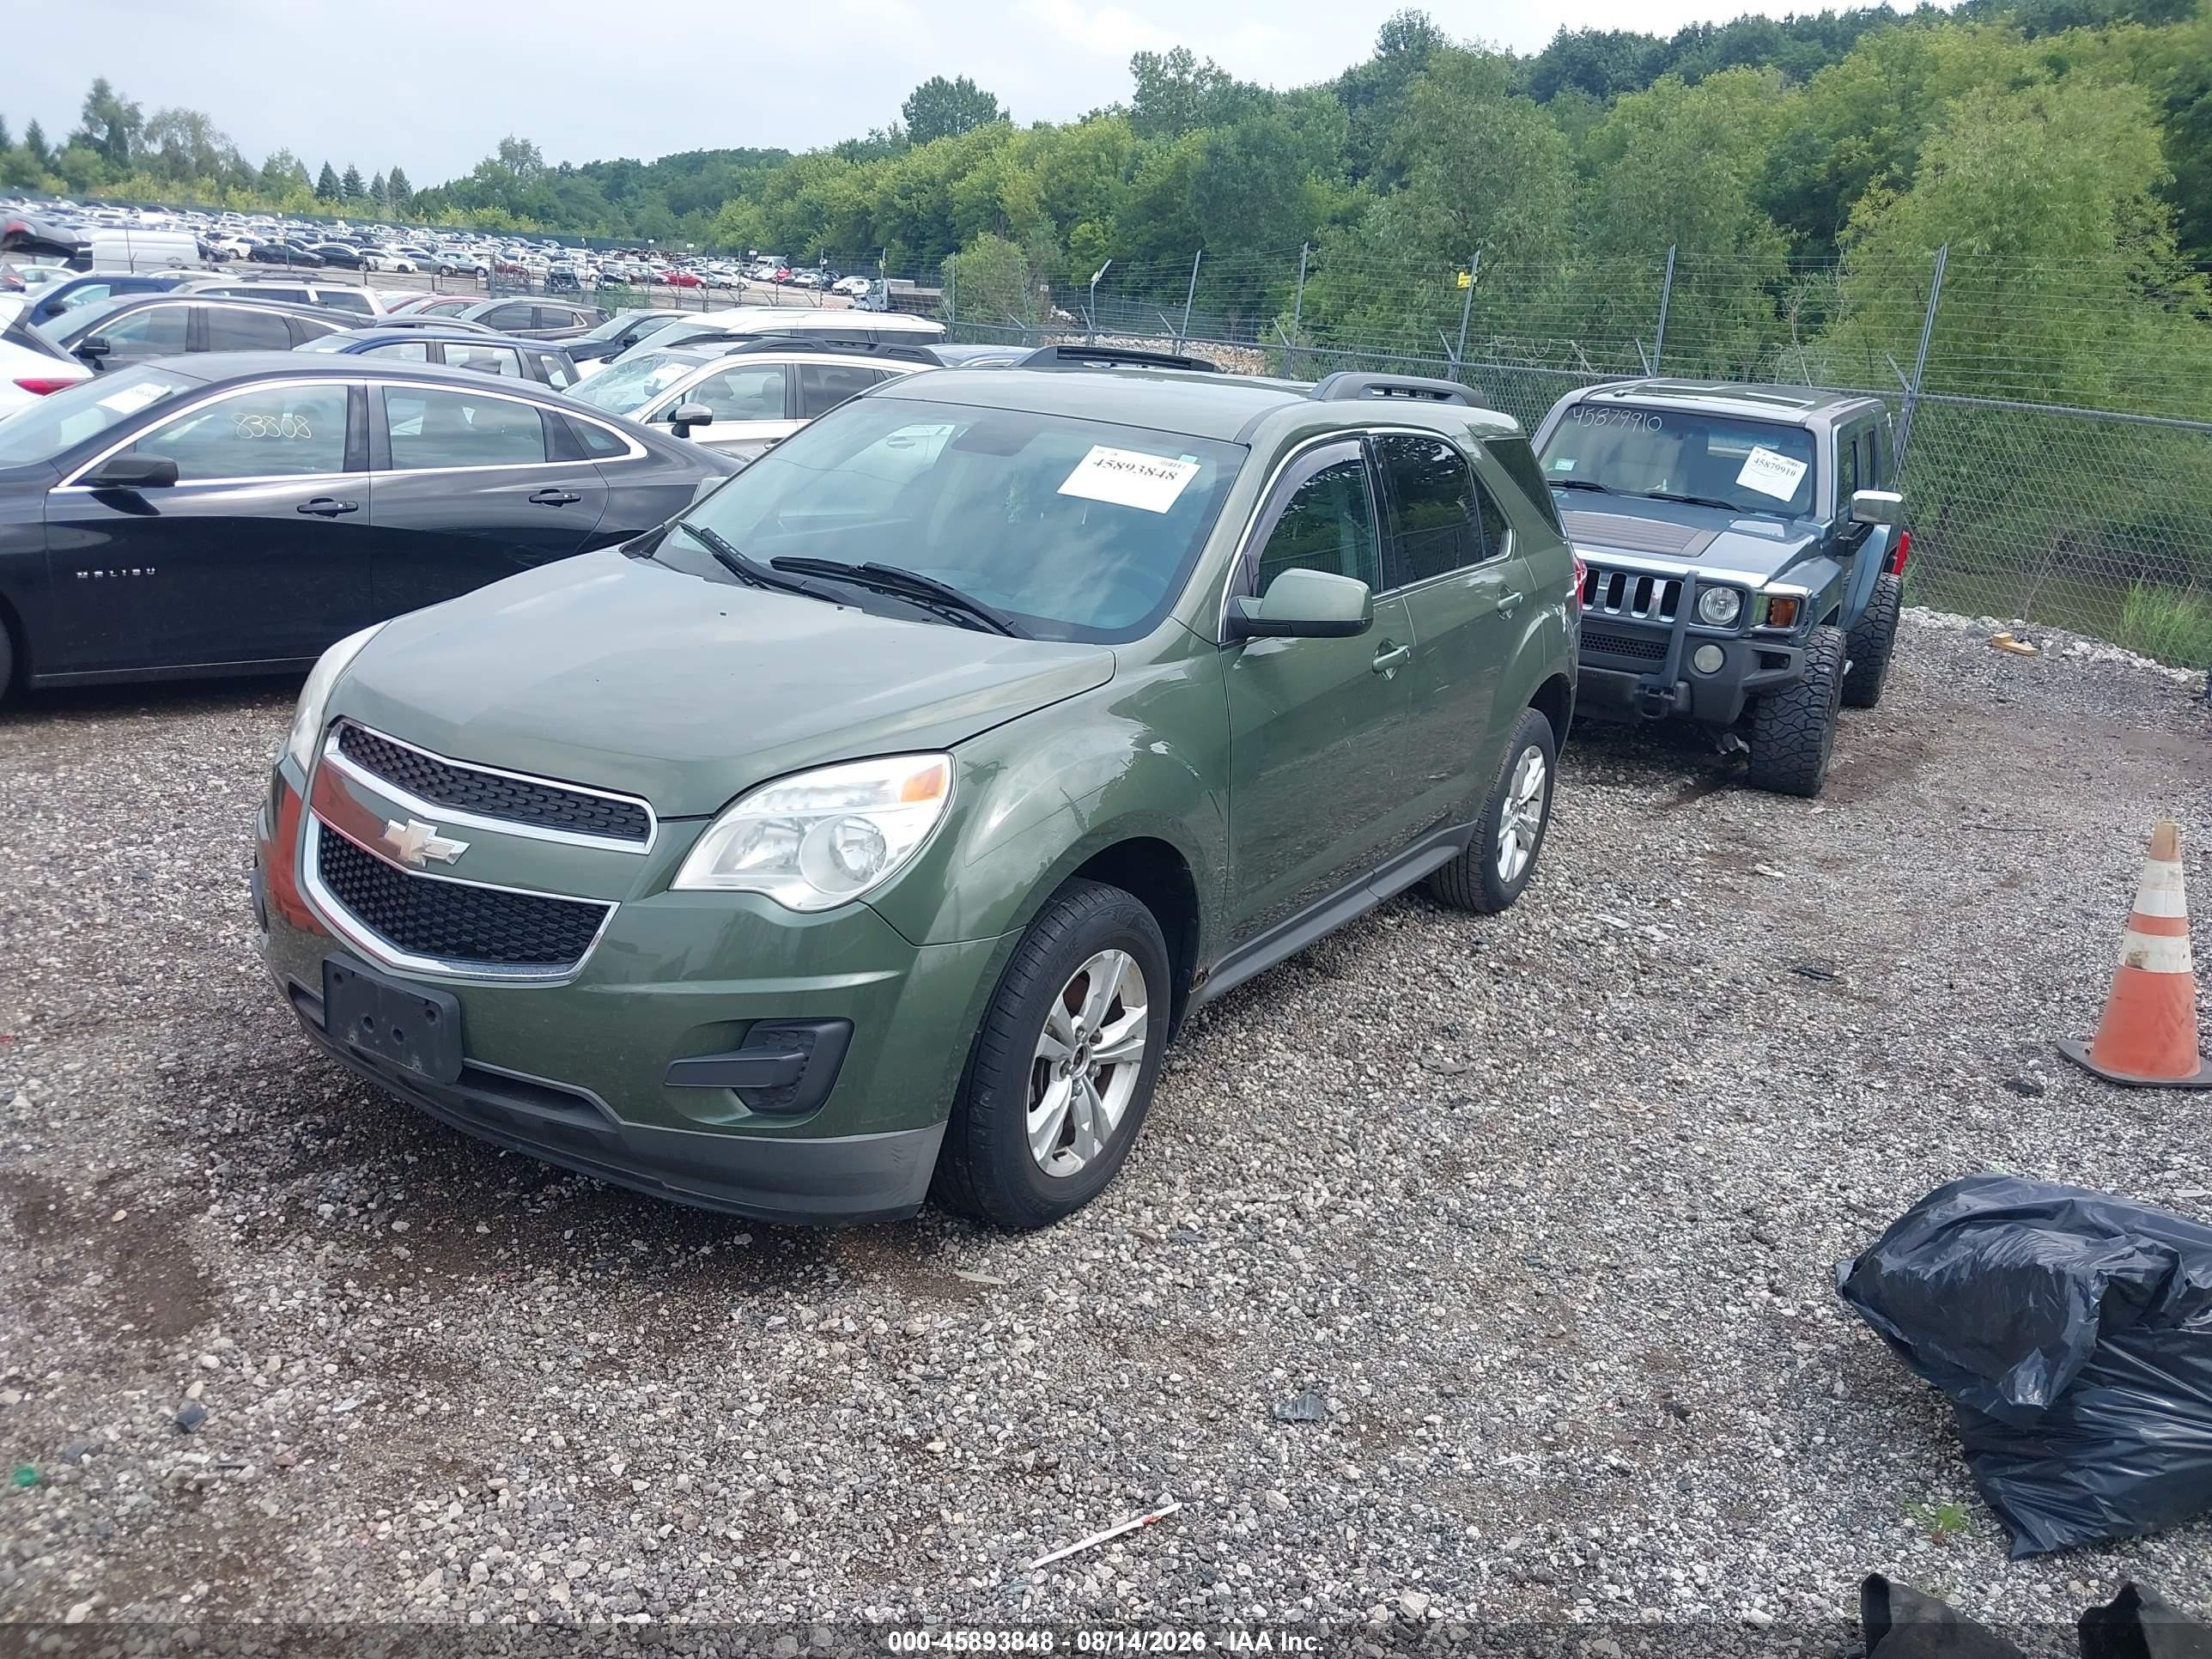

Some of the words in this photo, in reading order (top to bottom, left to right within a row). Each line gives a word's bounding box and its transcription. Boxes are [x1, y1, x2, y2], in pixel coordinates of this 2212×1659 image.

[231, 413, 312, 439] 83808
[1573, 407, 1662, 433] 45879910
[1093, 458, 1178, 481] 45893848
[1753, 457, 1796, 477] 45879910
[76, 568, 155, 578] MALIBU
